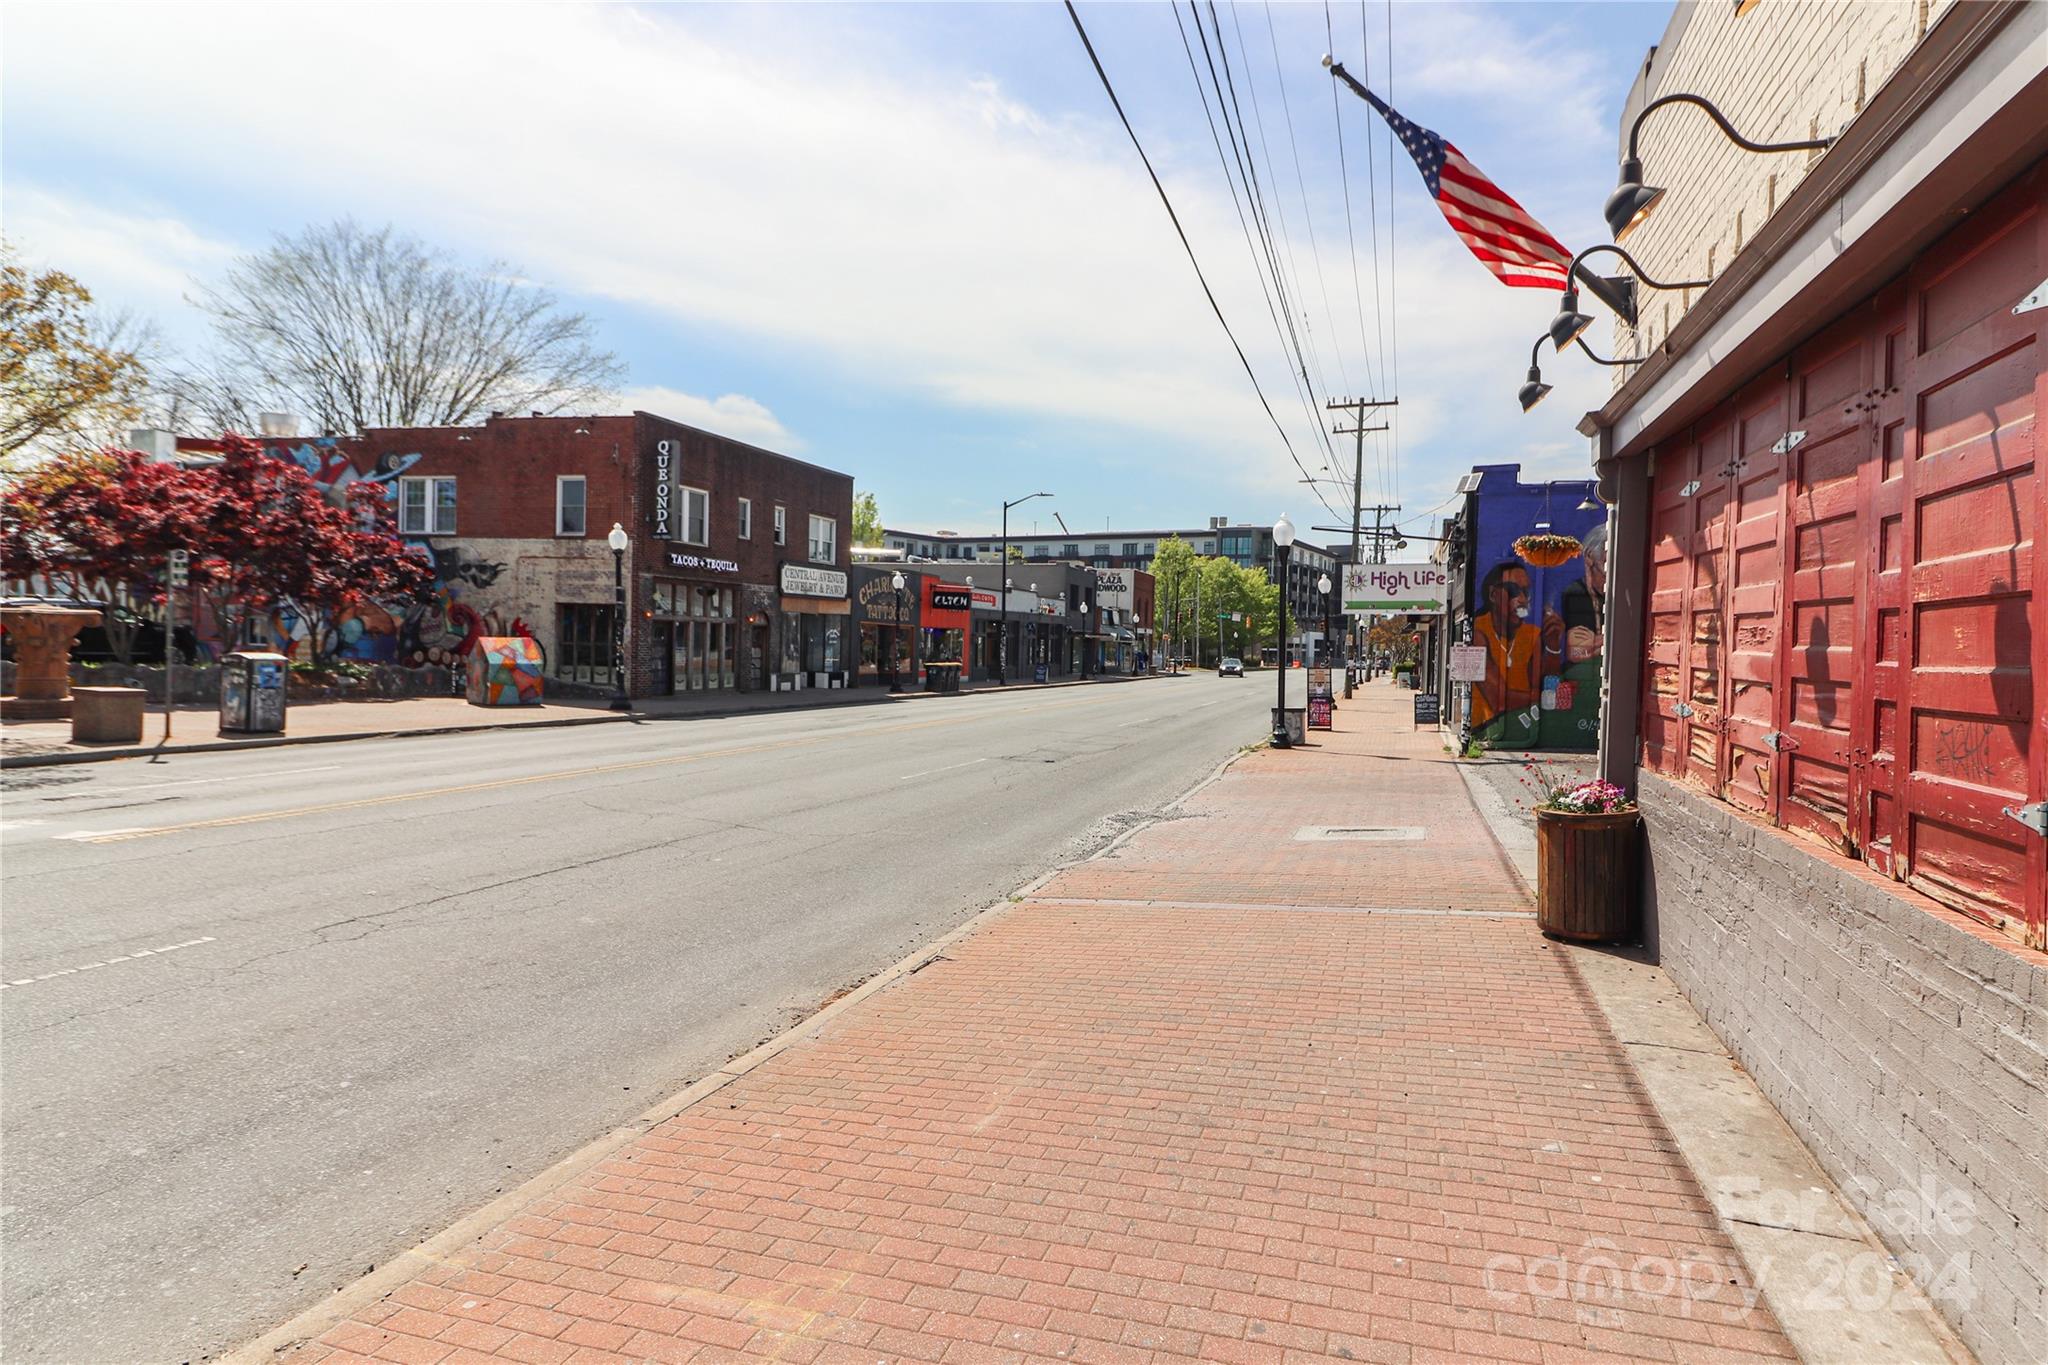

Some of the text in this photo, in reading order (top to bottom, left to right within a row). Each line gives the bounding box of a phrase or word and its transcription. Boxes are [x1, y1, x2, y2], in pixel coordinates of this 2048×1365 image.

[657, 440, 669, 481] QUE
[656, 484, 669, 533] ONDA
[671, 553, 698, 567] TACOS
[706, 558, 739, 572] TEQUILA
[784, 567, 845, 584] CENTRAL AVENUE
[1371, 571, 1410, 595] High
[1414, 571, 1445, 585] Life
[785, 580, 845, 595] JEWELRY & PAWN
